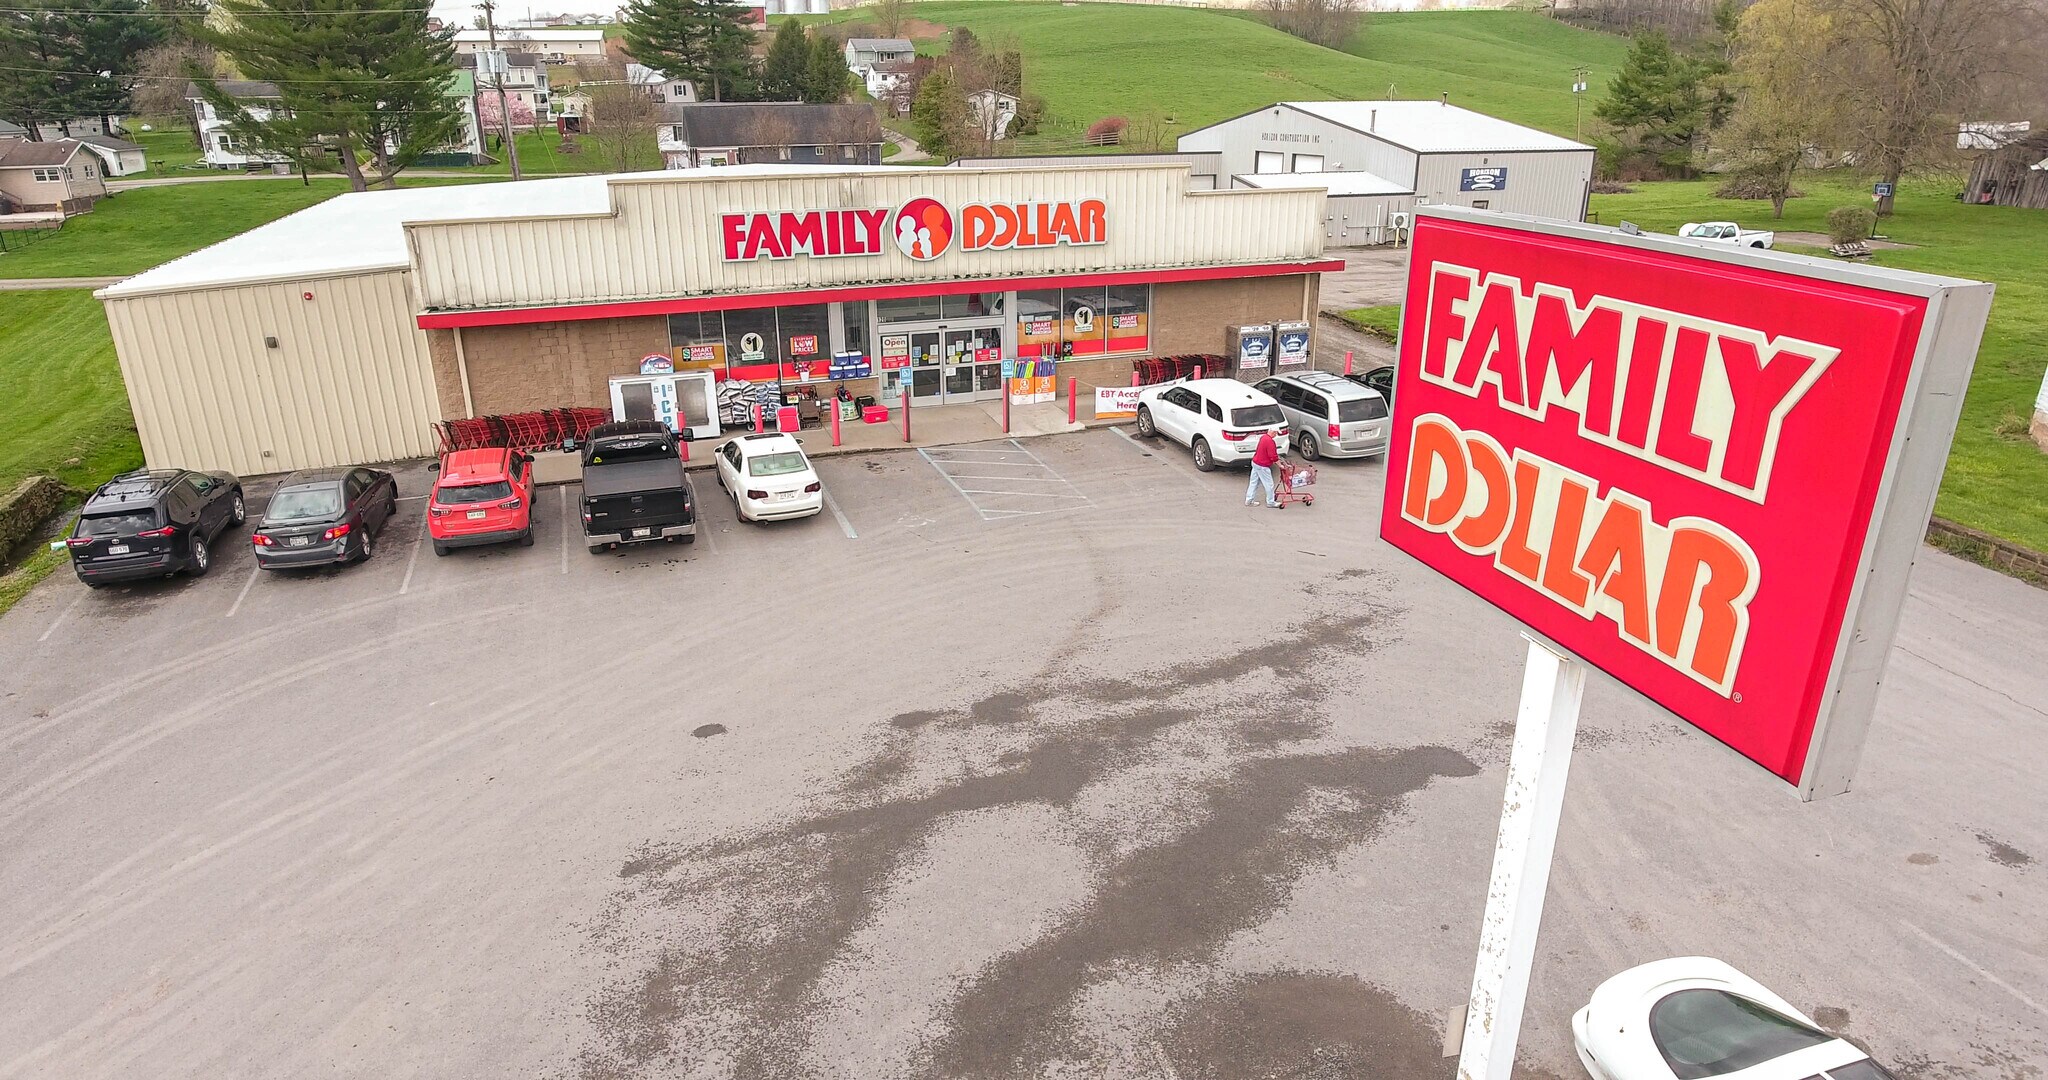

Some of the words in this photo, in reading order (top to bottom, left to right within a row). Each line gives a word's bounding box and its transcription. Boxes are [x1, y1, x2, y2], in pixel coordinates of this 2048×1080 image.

[1261, 132, 1278, 142] HORIZON
[1280, 133, 1310, 143] CONSTRUCTION
[721, 208, 891, 262] FAMILY
[960, 197, 1107, 251] DOLLAR
[745, 336, 757, 352] $1
[794, 340, 814, 348] LOW
[884, 338, 906, 347] Open
[1421, 262, 1838, 503] FAMILY
[1101, 390, 1116, 398] EBT
[1117, 390, 1139, 398] Acce
[1116, 401, 1138, 409] Here
[1402, 414, 1759, 698] DOLLAR
